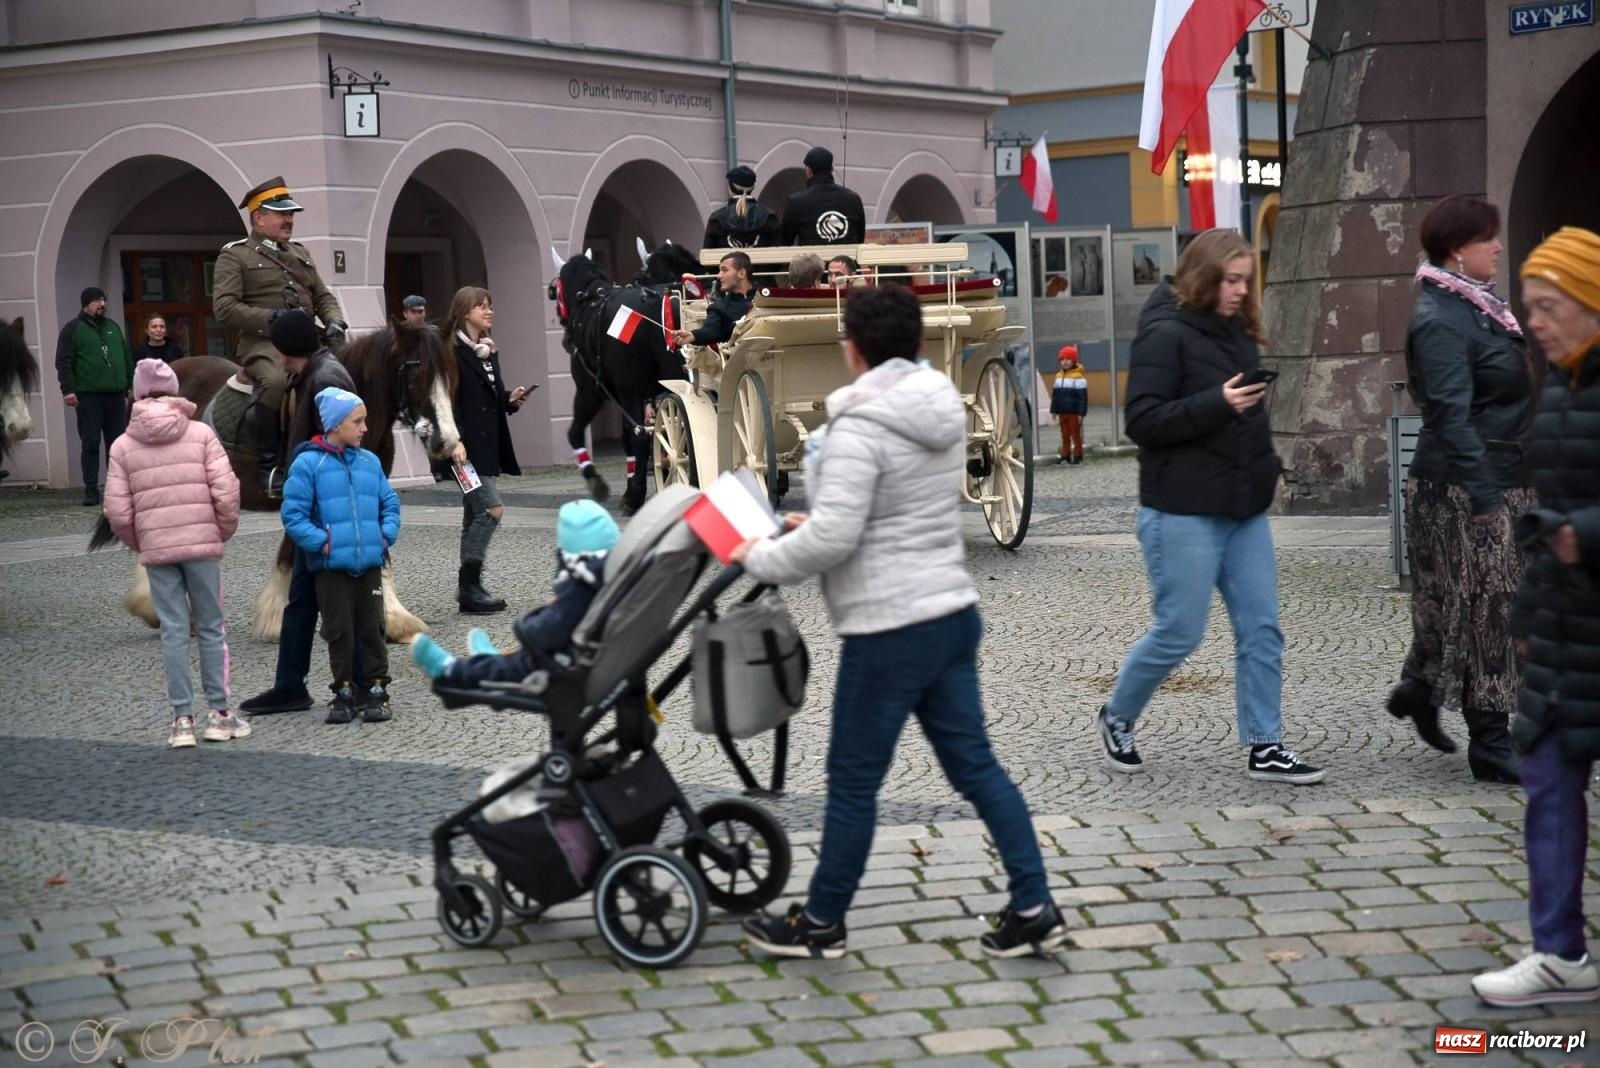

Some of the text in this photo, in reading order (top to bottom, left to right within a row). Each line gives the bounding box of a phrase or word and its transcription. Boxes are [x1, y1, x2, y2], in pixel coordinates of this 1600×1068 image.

[1515, 3, 1587, 27] RYNEK
[582, 82, 609, 100] Punkt
[612, 85, 657, 106] Informacji
[660, 90, 712, 111] Turystycznej
